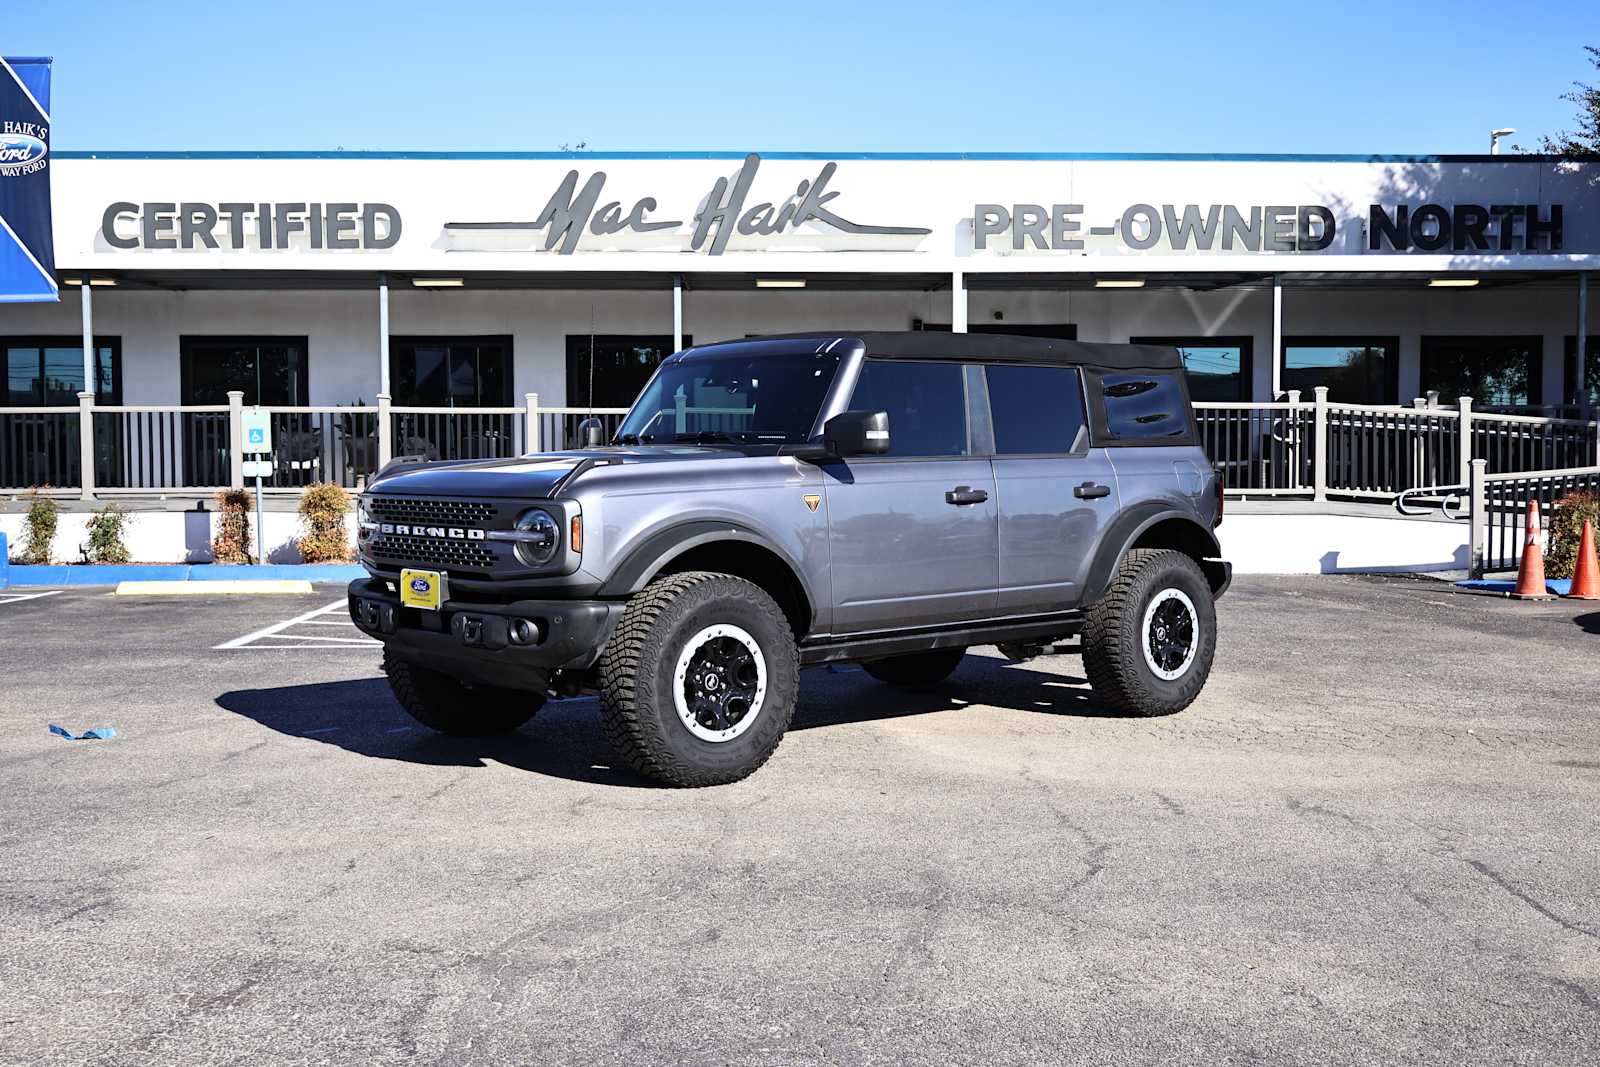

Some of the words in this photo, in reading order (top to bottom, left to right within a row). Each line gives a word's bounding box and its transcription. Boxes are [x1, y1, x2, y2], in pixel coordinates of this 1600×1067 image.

[4, 121, 47, 139] HAIK'S
[23, 160, 46, 175] FORD
[444, 170, 683, 256] Mac
[691, 153, 933, 257] Haik
[102, 201, 402, 250] CERTIFIED
[974, 203, 1336, 251] PRE-OWNED
[1369, 203, 1564, 251] NORTH
[381, 523, 485, 540] BRONCO
